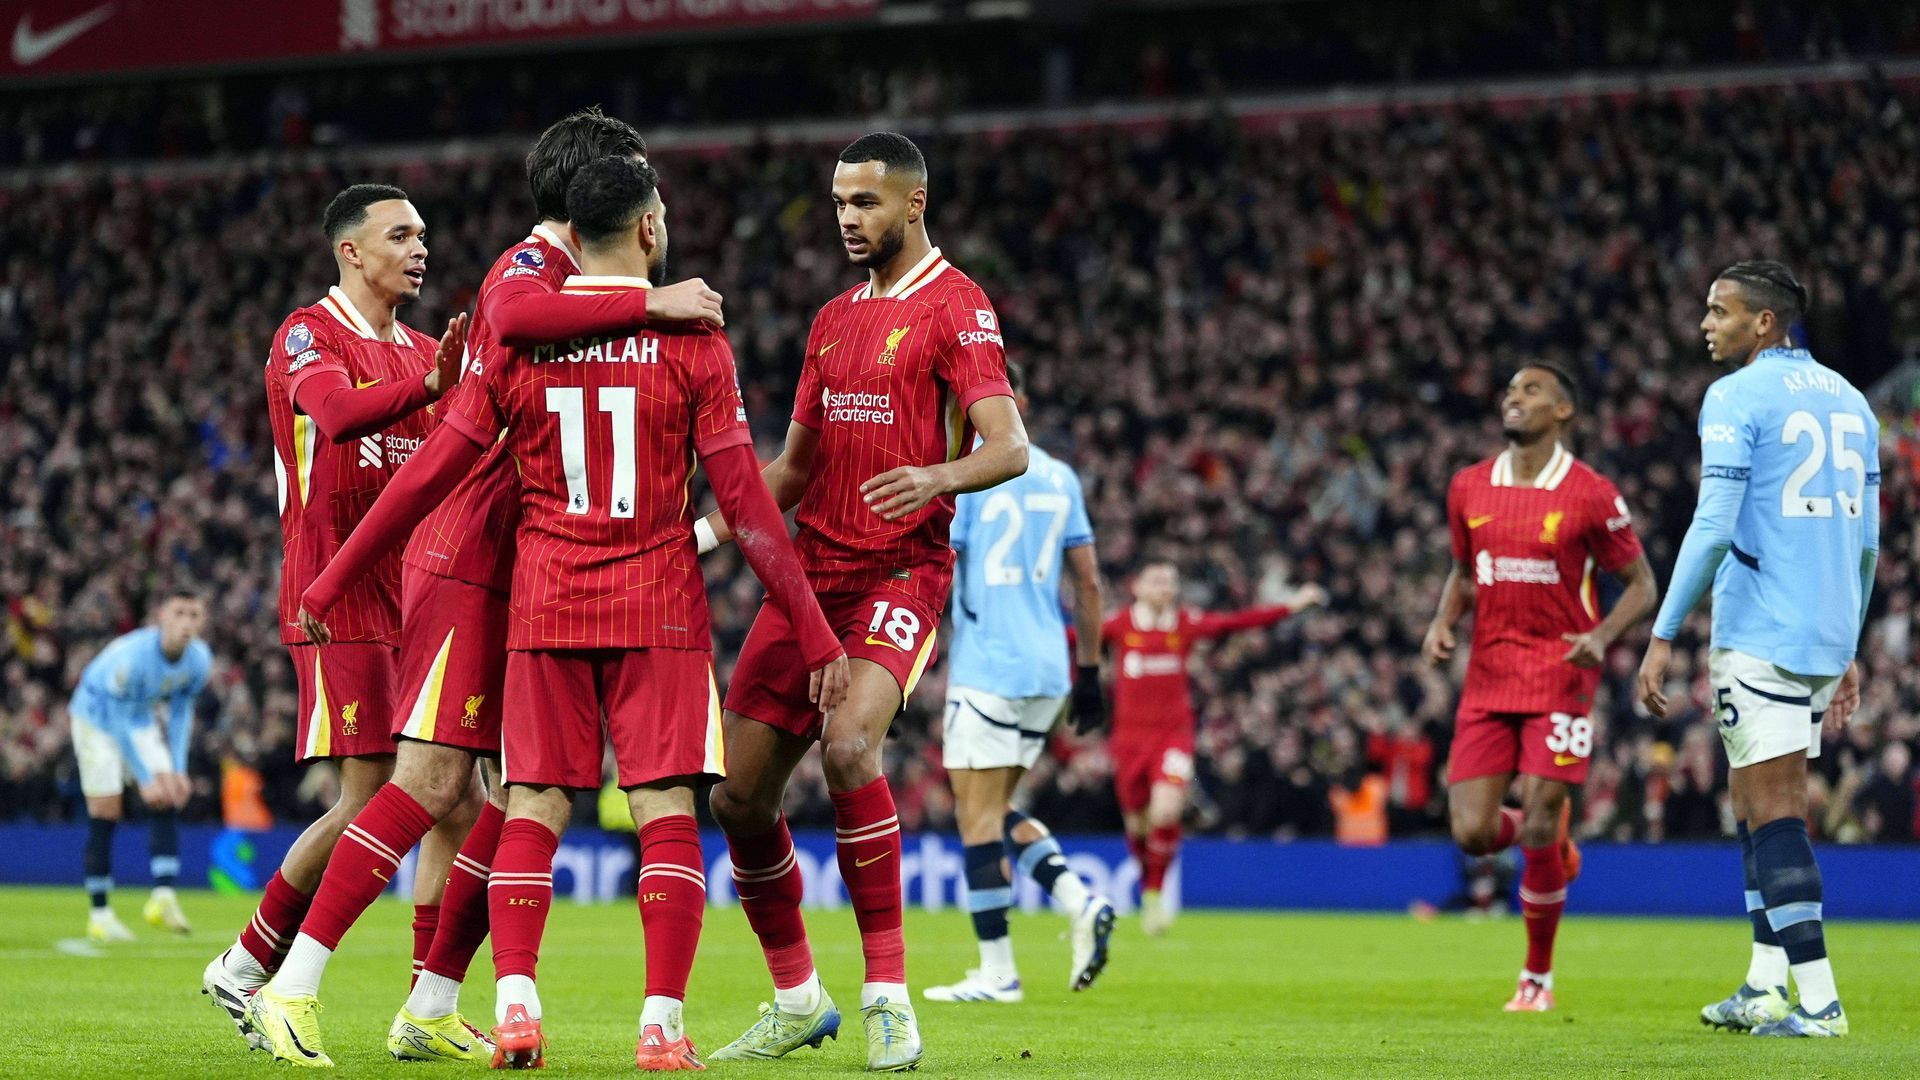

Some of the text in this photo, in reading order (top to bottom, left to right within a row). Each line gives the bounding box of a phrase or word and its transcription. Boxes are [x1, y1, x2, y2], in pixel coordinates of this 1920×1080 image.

[533, 336, 659, 364] M.SALAH
[1782, 370, 1842, 397] AKANJI
[545, 387, 638, 519] 11
[1781, 410, 1866, 519] 25
[980, 491, 1071, 586] 27
[868, 601, 920, 652] 18
[1545, 712, 1594, 758] 38
[508, 898, 540, 907] LFC
[643, 892, 667, 903] LFC
